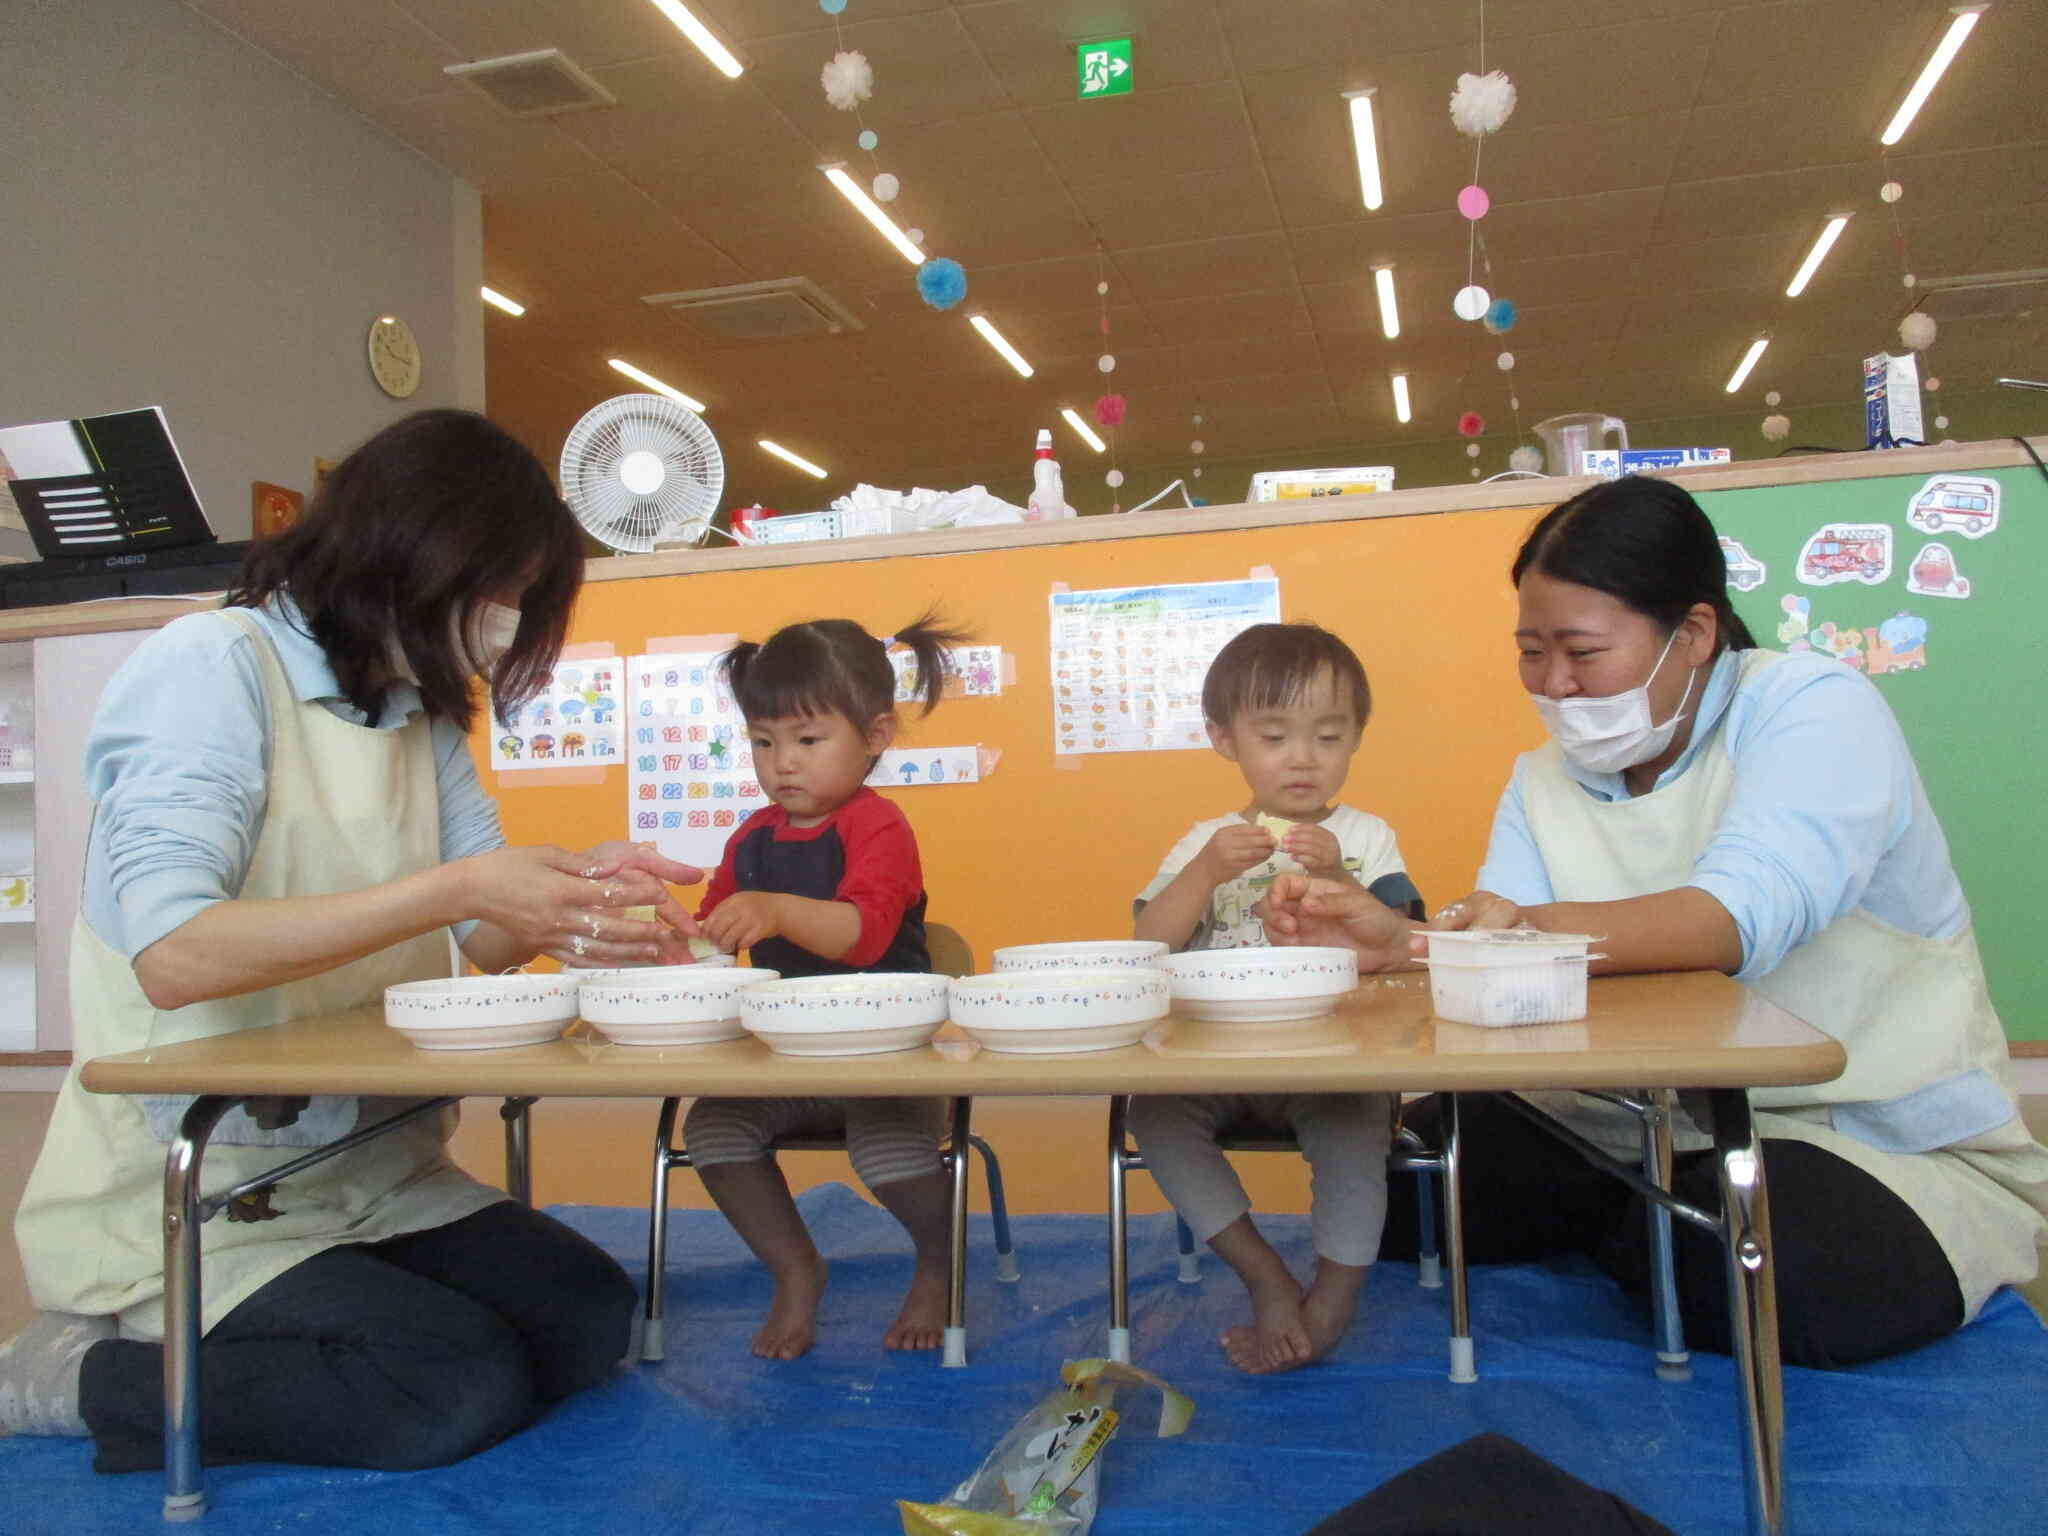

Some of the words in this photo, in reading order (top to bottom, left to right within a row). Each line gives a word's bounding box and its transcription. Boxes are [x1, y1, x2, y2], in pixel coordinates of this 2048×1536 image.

[106, 553, 147, 567] CASIO
[641, 673, 651, 688] 1
[665, 671, 678, 687] 2
[637, 727, 654, 743] 11
[662, 726, 680, 743] 12
[663, 754, 681, 771] 17
[639, 783, 656, 800] 21
[663, 783, 682, 799] 22
[638, 811, 658, 829] 26
[662, 811, 682, 828] 27
[713, 810, 735, 827] 29
